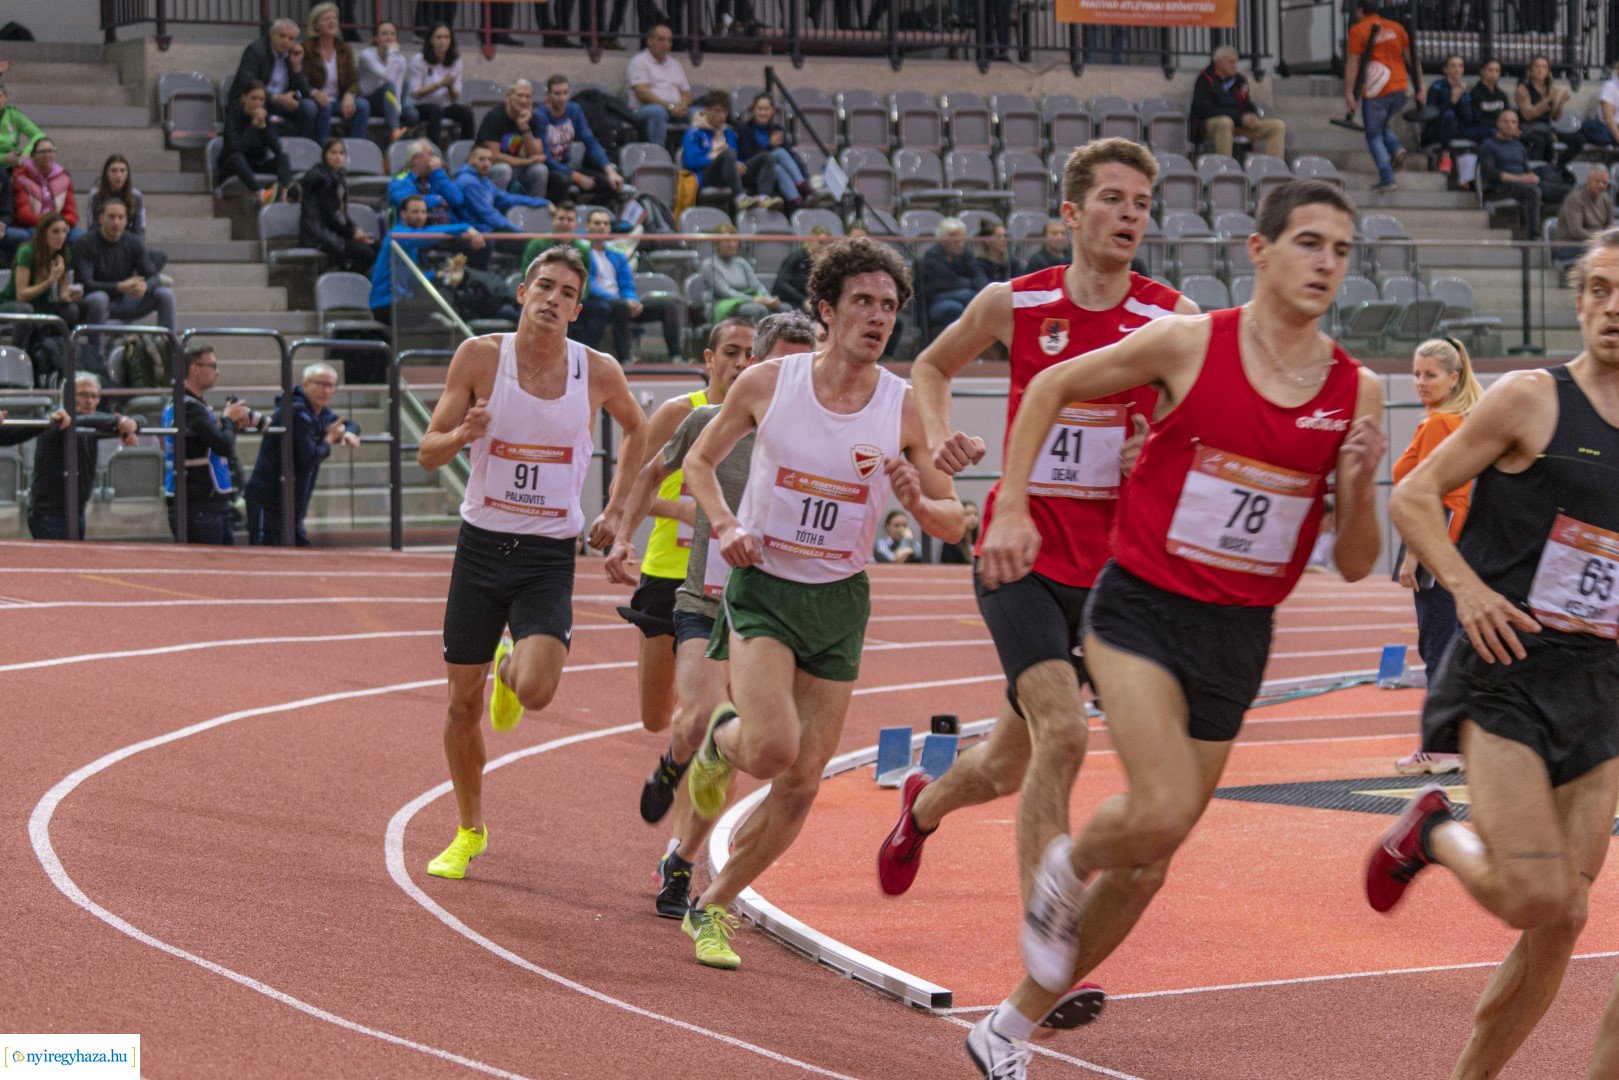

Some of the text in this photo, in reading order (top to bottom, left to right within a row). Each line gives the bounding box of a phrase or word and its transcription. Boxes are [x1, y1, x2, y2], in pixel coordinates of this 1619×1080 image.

[1050, 427, 1083, 464] 41
[514, 463, 539, 491] 91
[492, 501, 540, 515] NYÍREGYHÁZA
[506, 491, 545, 506] PALKOVITS
[801, 497, 838, 531] 110
[1225, 487, 1272, 534] 78
[795, 529, 826, 546] TÓTH B.
[770, 541, 824, 557] NYÍREGYHÁZA
